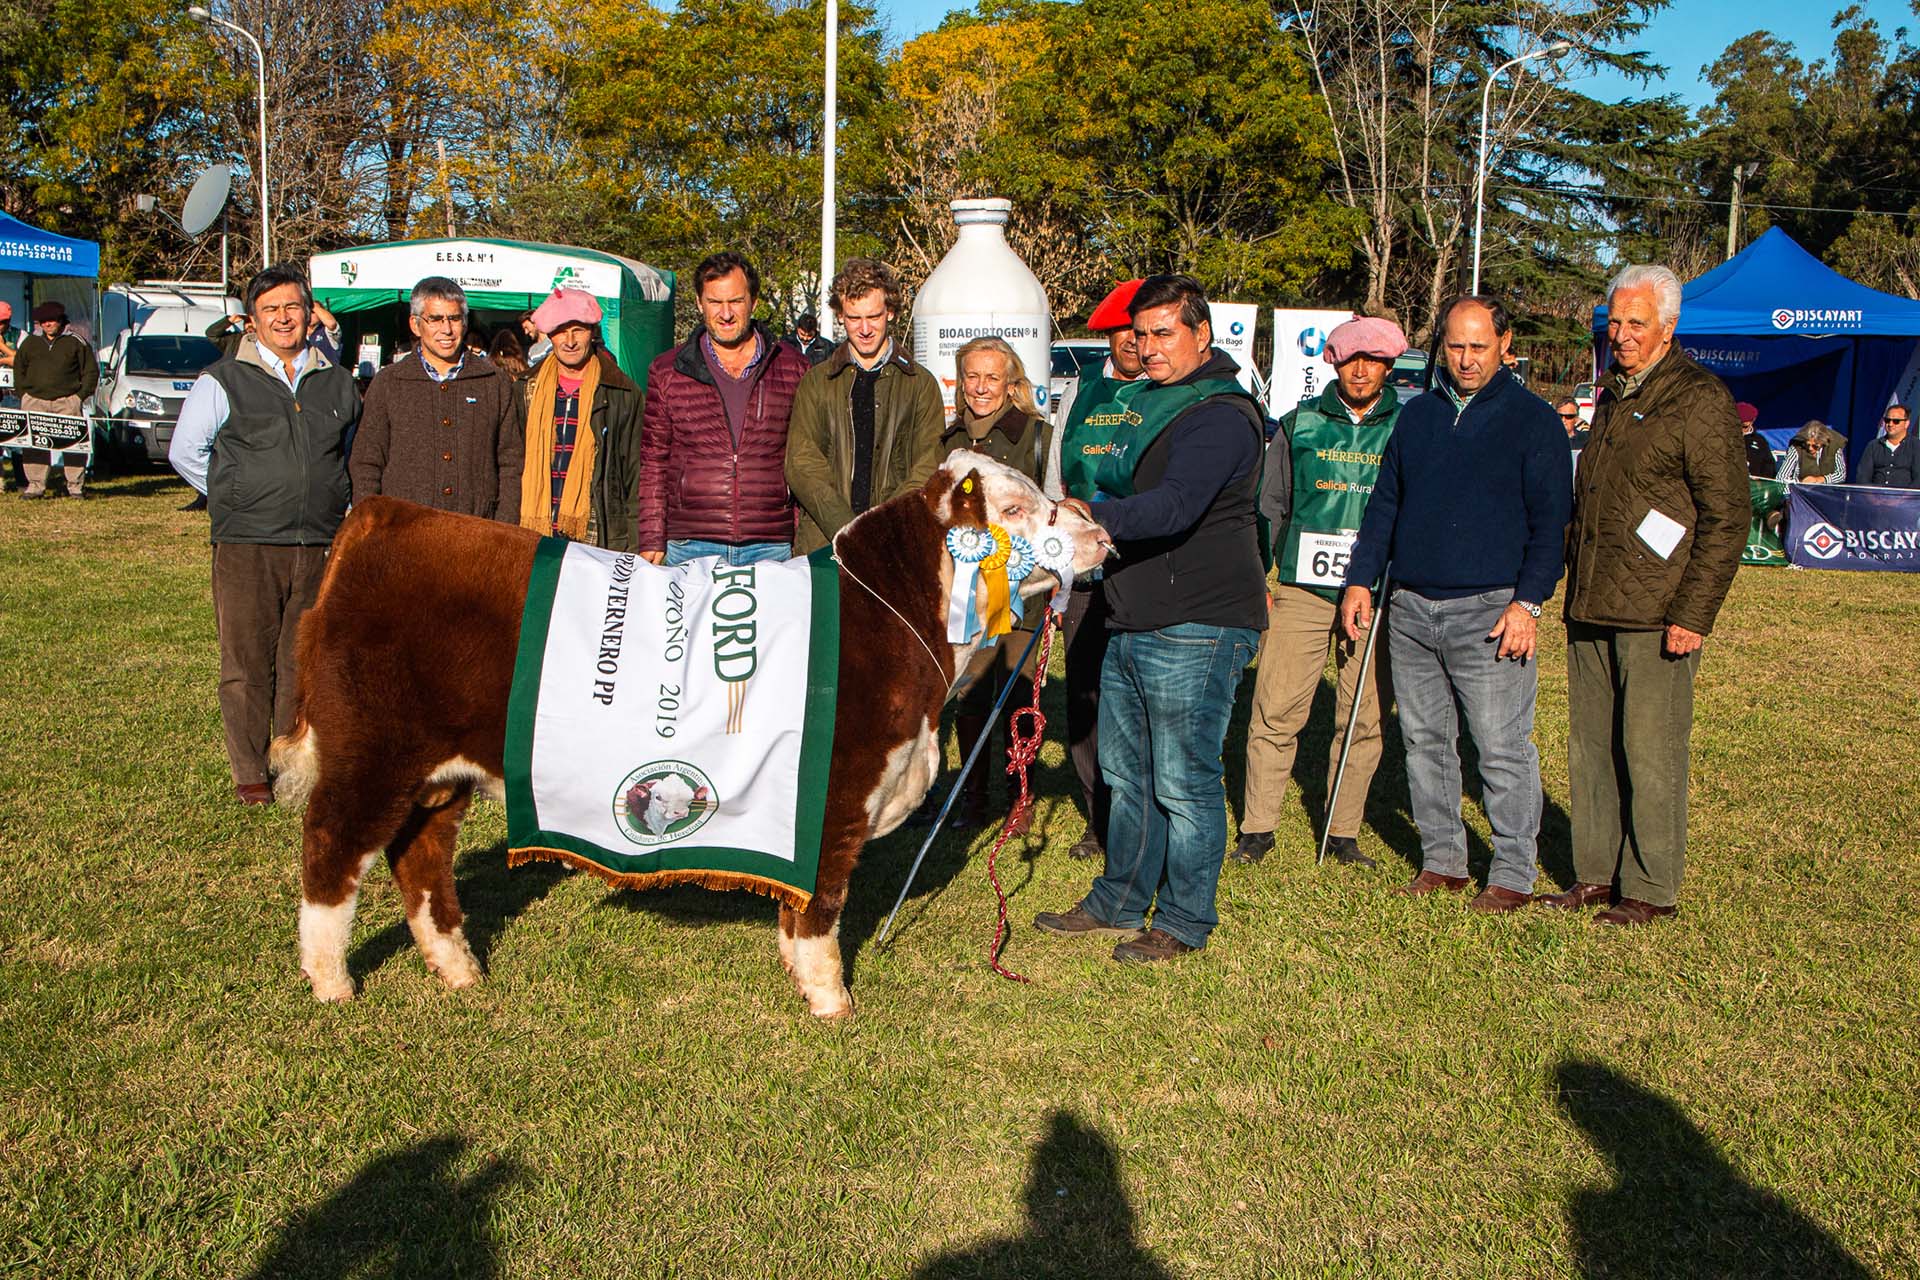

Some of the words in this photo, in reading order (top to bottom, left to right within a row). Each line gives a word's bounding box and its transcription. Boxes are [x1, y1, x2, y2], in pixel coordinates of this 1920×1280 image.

[1796, 309, 1863, 322] BISCAYART
[1032, 328, 1038, 338] H
[1225, 337, 1243, 347] Bagó
[1700, 350, 1761, 361] BISCAYART
[2, 374, 9, 384] 4
[31, 420, 63, 429] DISPONIBLE
[58, 418, 87, 426] SATELITAL
[34, 435, 48, 445] 20
[1315, 479, 1347, 491] Galicia
[1846, 530, 1920, 550] BISCAY
[664, 580, 689, 662] OTOÑO
[711, 559, 757, 683] FORD
[597, 584, 629, 675] TERNERO
[592, 679, 616, 706] PP
[656, 684, 681, 739] 2019
[630, 763, 672, 784] Asociación
[669, 819, 703, 840] Hereford
